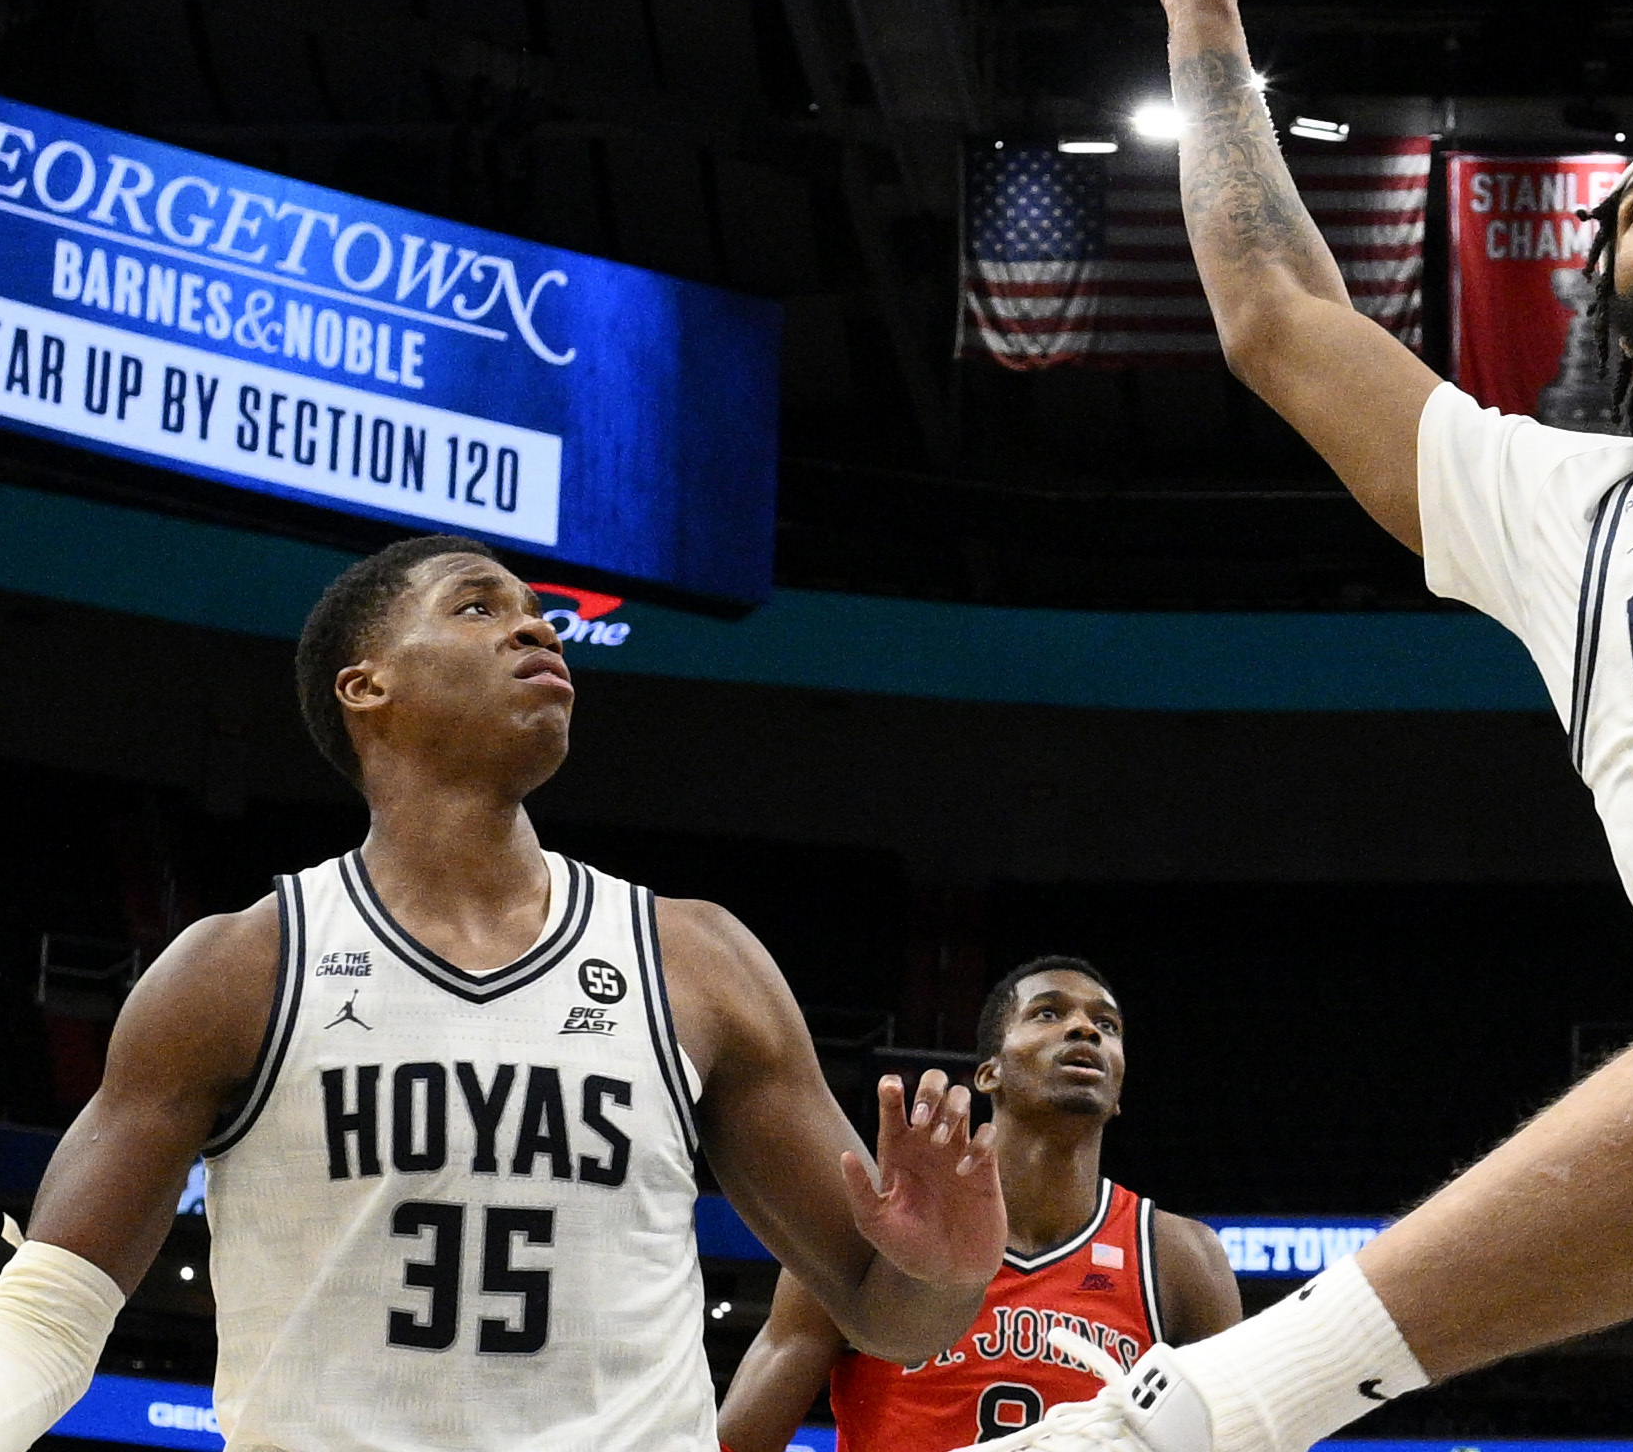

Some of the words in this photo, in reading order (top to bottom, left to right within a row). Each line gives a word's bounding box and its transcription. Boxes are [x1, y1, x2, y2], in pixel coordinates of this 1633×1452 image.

[1469, 170, 1622, 214] STANLE
[1485, 219, 1603, 261] CHAM
[84, 345, 143, 421] UP
[162, 365, 214, 443] BY
[236, 385, 426, 495] SECTION
[447, 434, 520, 514] 120
[316, 963, 372, 977] CHANGE
[322, 953, 342, 965] BE
[344, 951, 371, 964] THE
[563, 1019, 618, 1033] EAST
[568, 1006, 608, 1019] BIG
[321, 1060, 634, 1188] HOYAS
[1218, 1227, 1378, 1272] GETOW
[386, 1200, 558, 1357] 35
[147, 1401, 221, 1434] GEIC
